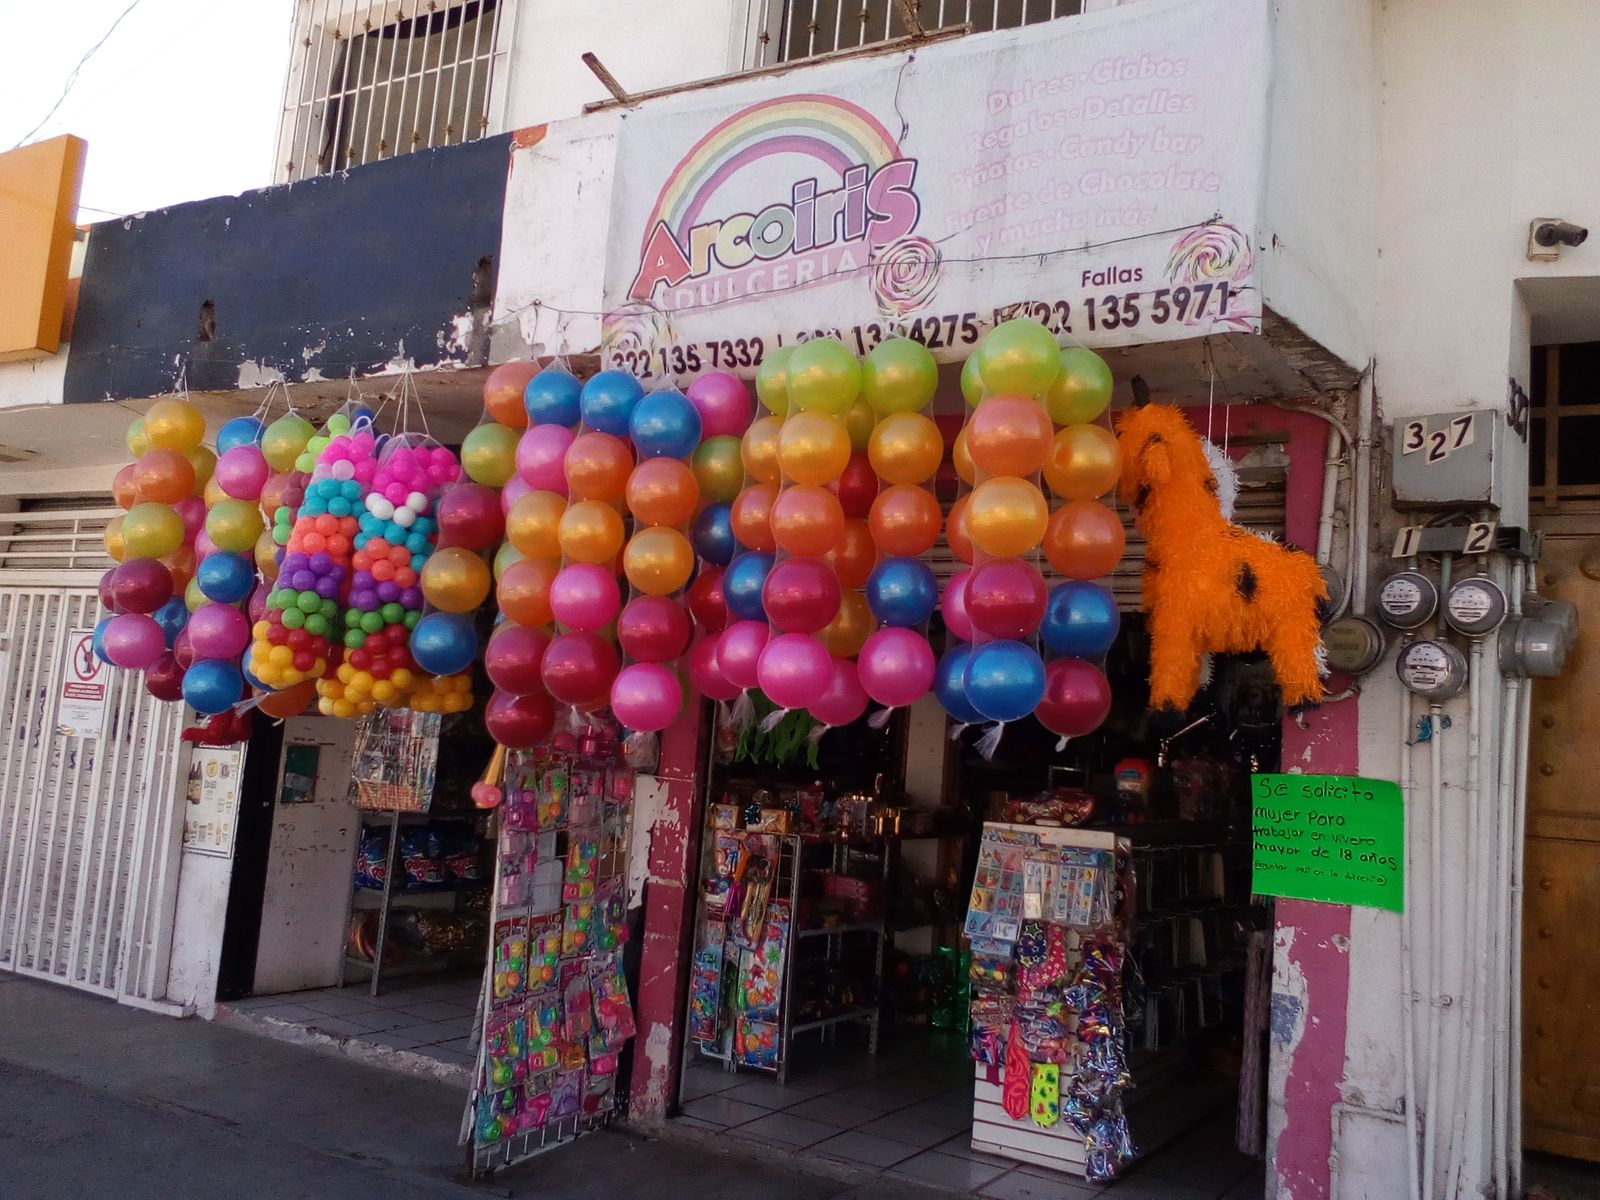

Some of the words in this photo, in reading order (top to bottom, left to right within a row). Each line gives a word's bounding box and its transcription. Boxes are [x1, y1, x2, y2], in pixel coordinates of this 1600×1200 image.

[986, 74, 1077, 116] Dulces
[1089, 54, 1192, 85] Globos
[966, 109, 1066, 153] Regalos
[1081, 88, 1199, 121] Detalles
[946, 148, 1043, 196] Piñatas
[1058, 126, 1149, 160] Candy
[1152, 125, 1204, 154] bar
[944, 190, 1033, 233] Fuente
[1037, 176, 1073, 206] de
[1079, 162, 1223, 196] Chocolate
[998, 207, 1088, 243] mucho
[1095, 199, 1154, 228] más
[674, 250, 858, 308] DULCERIA
[1082, 266, 1144, 288] Fallas
[659, 344, 701, 376] 135
[706, 336, 764, 368] 7332
[909, 312, 979, 349] 4275
[1083, 292, 1141, 332] 135
[1150, 281, 1230, 325] 5971
[1401, 528, 1414, 556] 1
[1467, 524, 1490, 552] 2
[1259, 778, 1288, 799] Se
[1255, 806, 1300, 824] mujer
[1252, 826, 1303, 840] trabajar
[1311, 832, 1326, 841] en
[1332, 834, 1376, 847] vivero
[1255, 841, 1300, 856] mayor
[1311, 845, 1330, 859] de
[1340, 848, 1352, 861] 18
[1360, 852, 1397, 871] años
